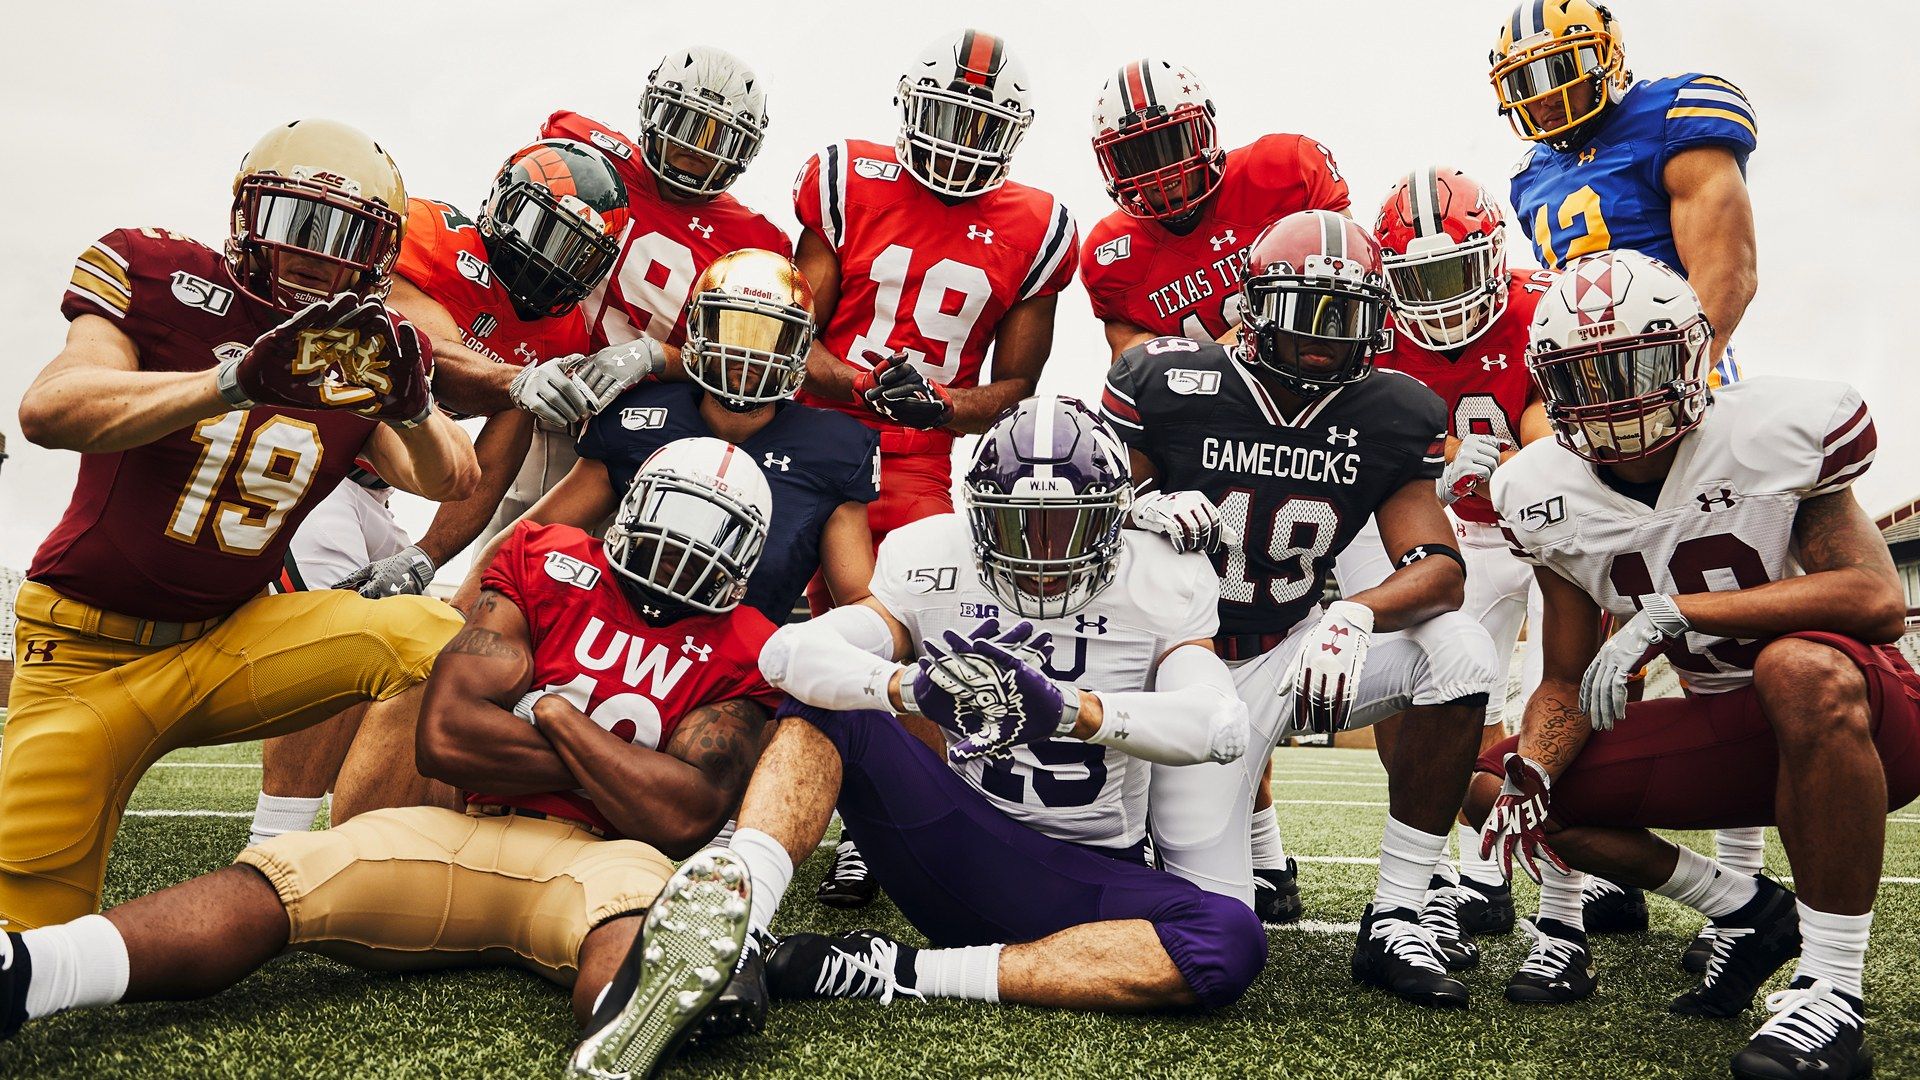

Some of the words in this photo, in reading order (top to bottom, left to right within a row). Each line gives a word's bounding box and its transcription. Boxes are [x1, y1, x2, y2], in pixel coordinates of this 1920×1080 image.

[309, 171, 346, 188] ACC
[853, 157, 903, 182] 150
[1094, 234, 1132, 266] 150
[170, 269, 235, 317] 150
[292, 291, 328, 303] schu
[742, 287, 773, 301] Riddell
[1148, 271, 1214, 320] TEXAS
[1212, 244, 1251, 289] TEC
[846, 243, 993, 386] 19
[1576, 322, 1617, 342] TUFF
[458, 326, 506, 364] LORAD
[1164, 367, 1222, 396] 150
[618, 406, 669, 431] 150
[1202, 436, 1361, 486] GAMECOCKS
[164, 408, 325, 557] 19
[1029, 480, 1060, 492] W.I.N.
[1515, 494, 1569, 533] 150
[1214, 486, 1343, 605] 19
[544, 550, 602, 591] 150
[904, 565, 960, 596] 150
[574, 616, 694, 701] UW
[1039, 636, 1089, 683] U
